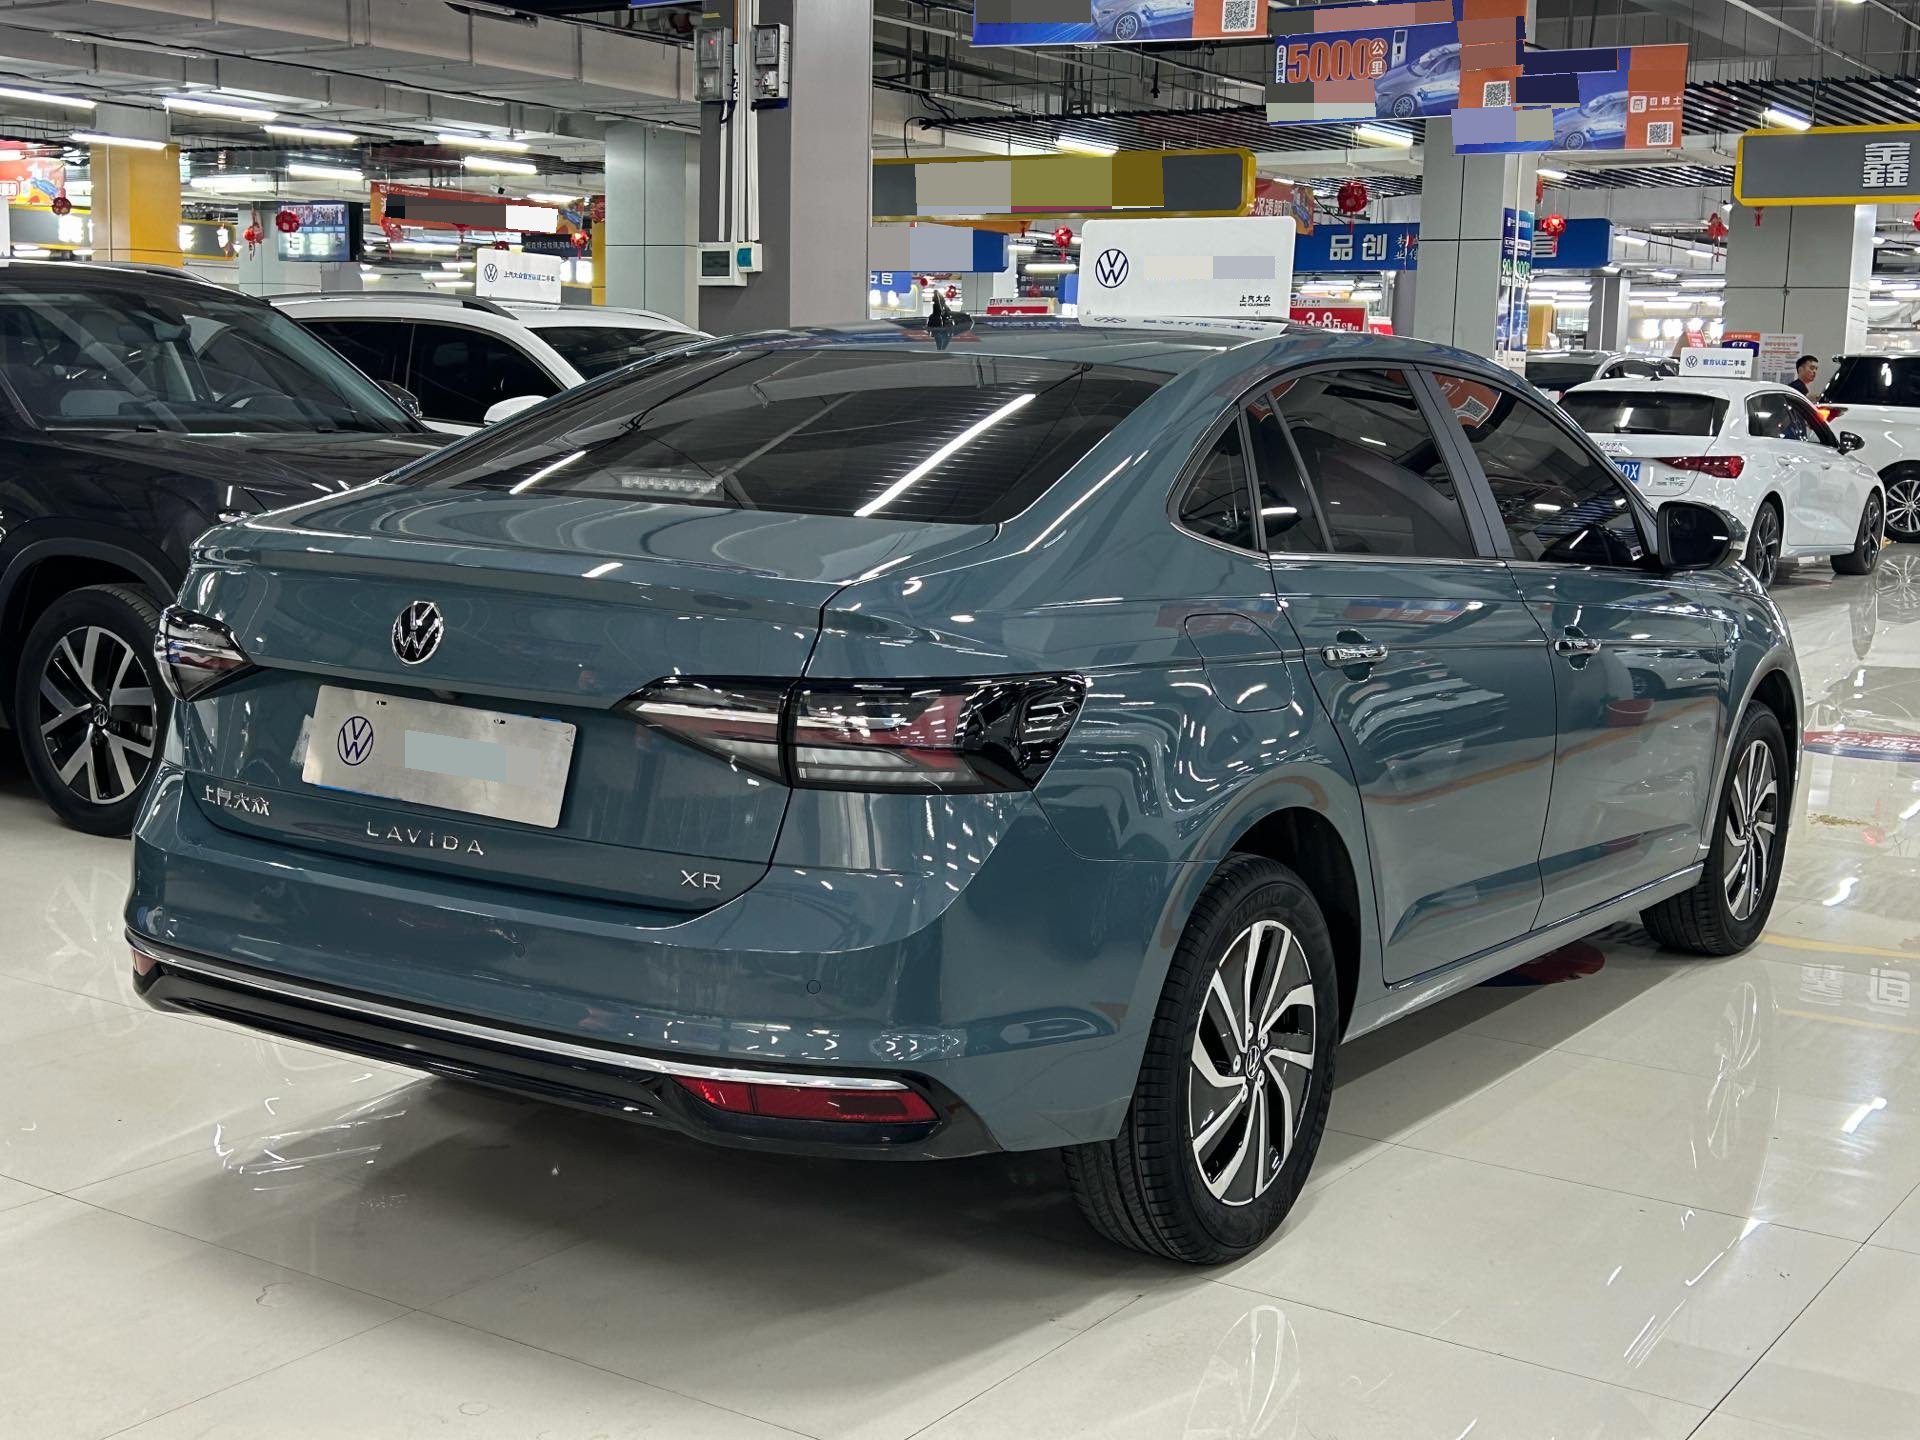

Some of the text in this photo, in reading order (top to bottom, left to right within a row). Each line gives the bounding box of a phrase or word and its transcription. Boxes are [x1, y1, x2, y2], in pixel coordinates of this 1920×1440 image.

[1287, 38, 1372, 83] 5000
[1862, 142, 1911, 188] 鑫
[1329, 233, 1388, 261] 品创
[1239, 294, 1271, 303] 上汽大众
[366, 820, 485, 856] LAVIDA
[681, 869, 722, 891] XR
